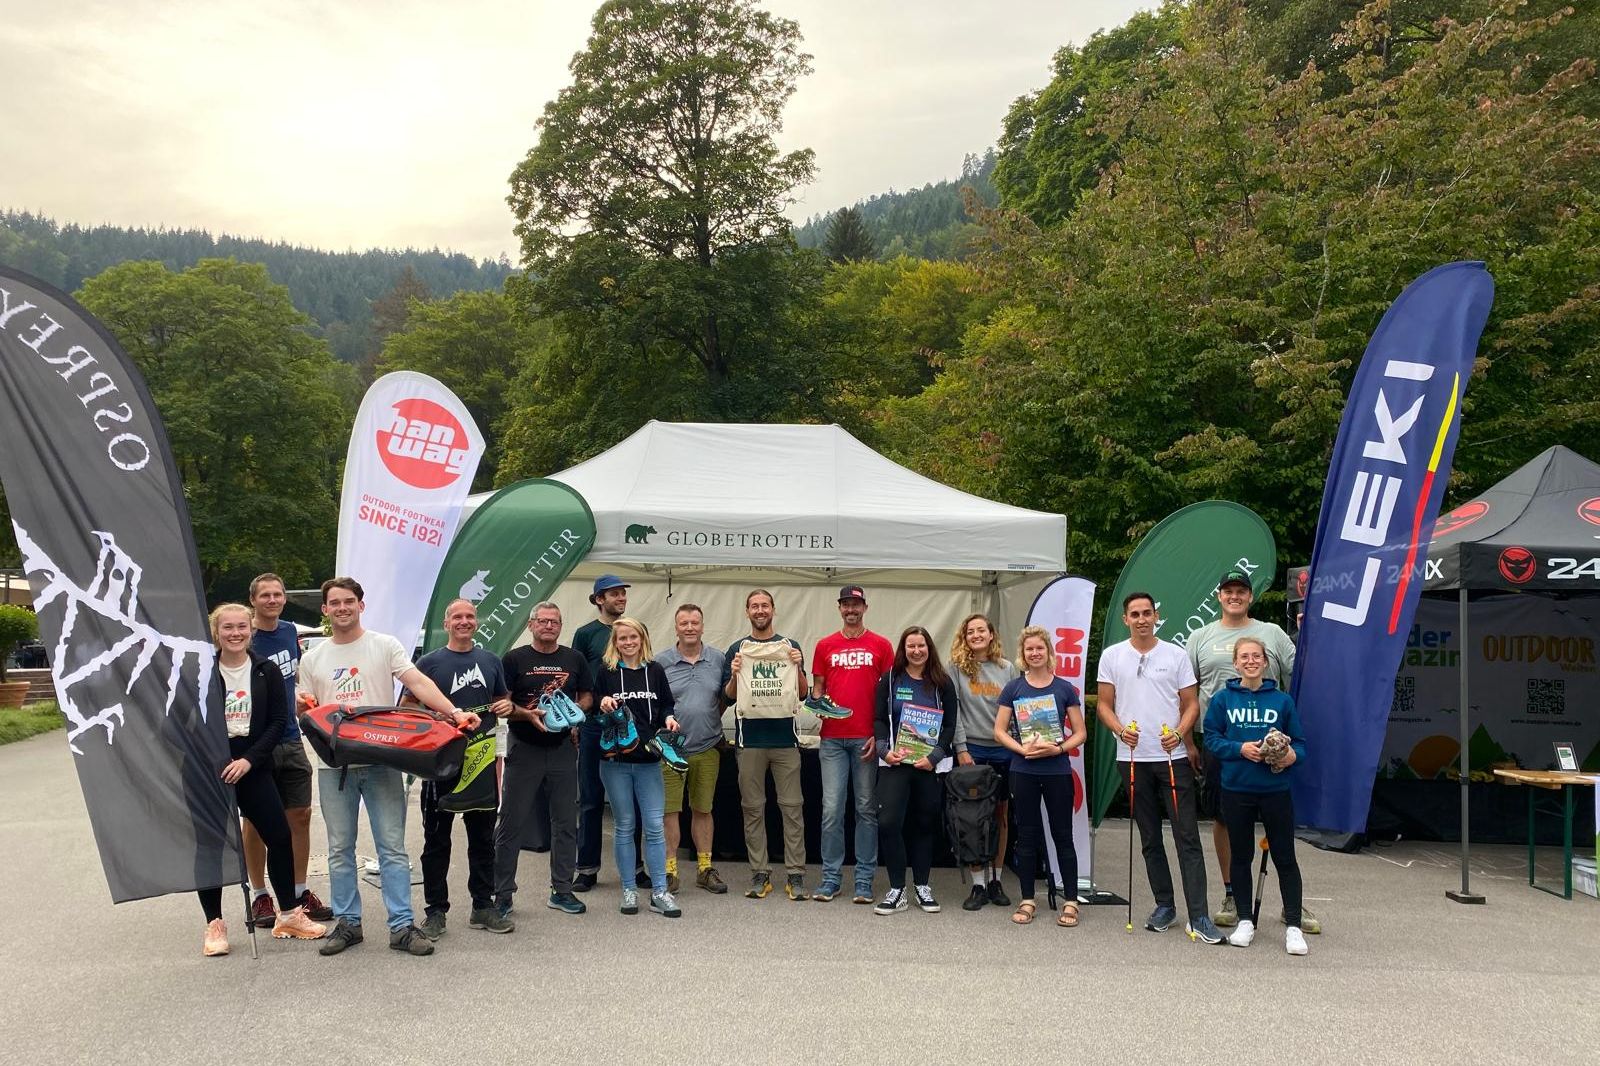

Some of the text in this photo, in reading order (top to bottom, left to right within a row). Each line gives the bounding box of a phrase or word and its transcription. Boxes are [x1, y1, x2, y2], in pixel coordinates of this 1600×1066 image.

[1321, 360, 1435, 627] LEKI
[362, 494, 446, 529] OUTDOOR FOOTWEAR
[359, 505, 443, 547] SINCE 1921
[667, 531, 834, 549] GLOBETROTTER
[1483, 635, 1596, 664] OUTDOOR
[831, 651, 873, 667] PACER
[450, 662, 487, 695] LOWA
[750, 679, 783, 689] ERLEBNIS
[335, 691, 364, 701] OSPREY
[612, 691, 658, 701] SCARPA
[751, 689, 782, 697] HUNGRIG
[903, 708, 936, 720] wander
[903, 715, 939, 728] magazin
[363, 731, 401, 744] OSPREY
